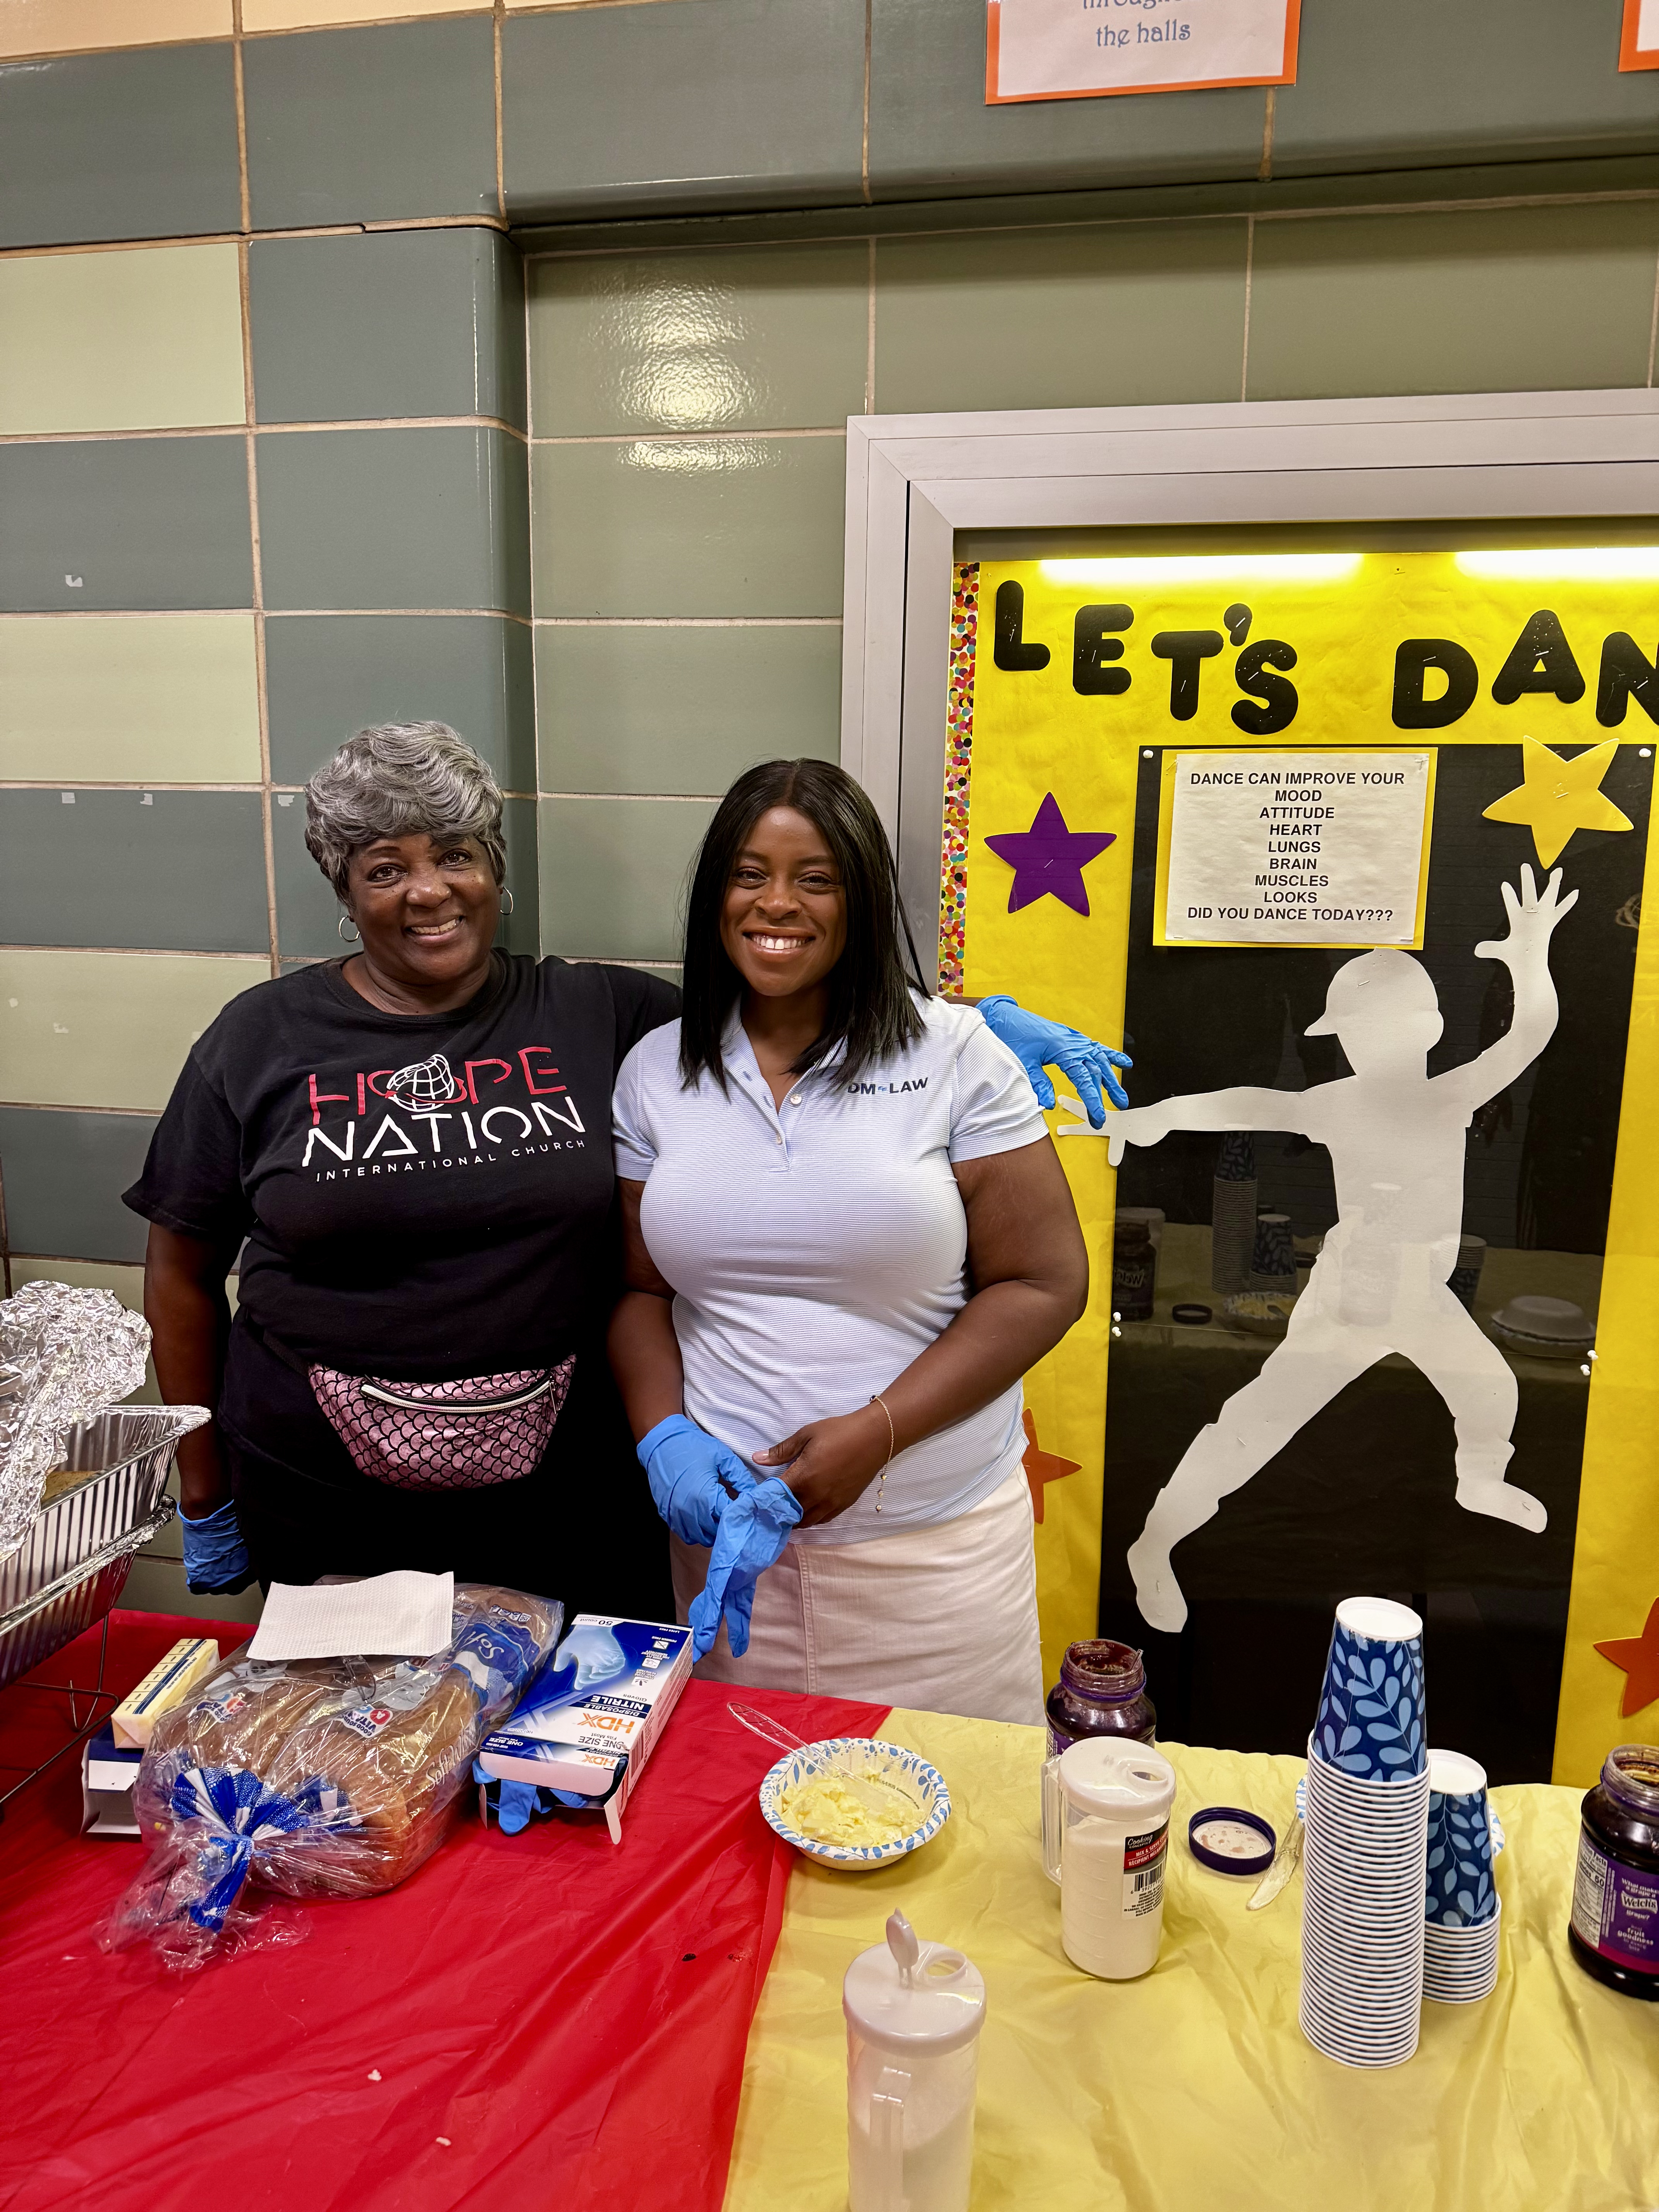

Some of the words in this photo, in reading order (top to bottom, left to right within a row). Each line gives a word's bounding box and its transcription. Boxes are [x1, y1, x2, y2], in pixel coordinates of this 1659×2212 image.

[1096, 24, 1130, 48] the
[1137, 19, 1190, 43] halls
[994, 580, 1298, 735] LET'S
[1191, 773, 1243, 785] DANCE
[1249, 773, 1281, 785] CAN
[1286, 772, 1356, 785] IMPROVE
[1361, 772, 1405, 785] YOUR
[1275, 790, 1322, 802] MOOD
[1260, 807, 1334, 819] ATTITUDE
[1270, 824, 1322, 836] HEART
[1268, 841, 1321, 853] LUNGS
[1269, 858, 1317, 870] BRAIN
[1255, 875, 1329, 887] MUSCLES
[1264, 891, 1317, 903] LOOKS
[1188, 907, 1212, 919] DID
[1218, 907, 1249, 919] YOU
[1254, 908, 1307, 920] DANCE
[1312, 909, 1393, 922] TODAY???
[890, 1077, 928, 1094] LAW
[302, 1096, 586, 1167] NATION
[316, 1155, 496, 1182] INTERNATIONAL
[512, 1139, 586, 1157] CHURCH
[590, 1695, 644, 1711] NITRILE
[623, 1694, 647, 1702] Gloves
[584, 1704, 640, 1717] DISPOSABLE
[577, 1713, 635, 1733] HDX
[356, 1724, 372, 1736] GOOD
[578, 1736, 601, 1745] SIZE
[603, 1740, 624, 1749] ONE
[582, 1754, 616, 1767] HDX
[426, 1748, 450, 1793] Soft
[1128, 1834, 1152, 1846] Cooking
[1595, 1875, 1604, 1887] 50
[1623, 1896, 1656, 1908] Welch's
[1618, 1930, 1654, 1946] goodness
